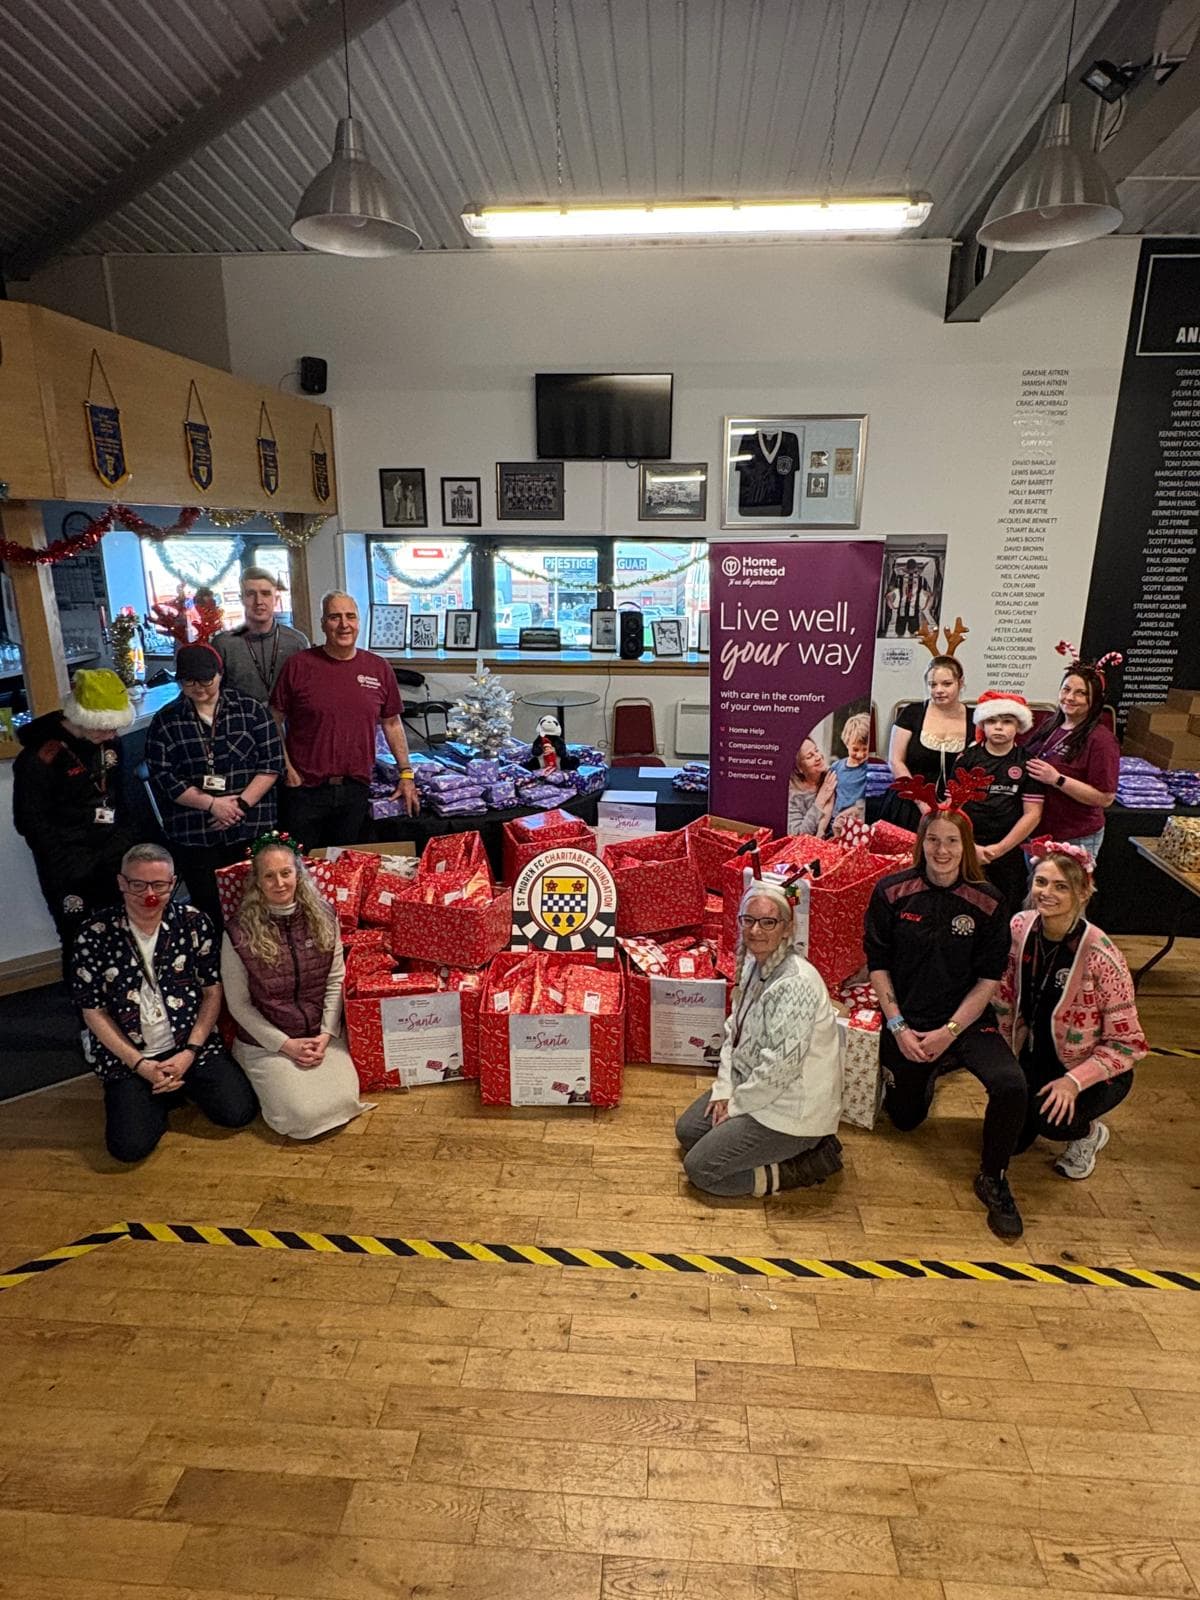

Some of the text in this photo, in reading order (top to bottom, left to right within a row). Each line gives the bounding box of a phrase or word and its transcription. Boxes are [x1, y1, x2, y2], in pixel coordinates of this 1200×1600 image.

[618, 559, 646, 569] GUAR
[743, 556, 777, 566] Home
[742, 566, 785, 576] Instead
[720, 602, 856, 635] Live well,
[720, 639, 790, 681] your
[798, 643, 862, 674] way
[721, 690, 739, 699] with
[761, 691, 771, 700] in
[772, 692, 787, 700] the
[789, 693, 825, 702] comfort
[721, 702, 729, 710] of
[730, 704, 751, 713] your
[773, 704, 800, 713] home
[749, 727, 765, 735] Help
[728, 742, 780, 752] Companionship
[728, 756, 773, 766] Personal Care
[728, 771, 776, 781] Dementia Care
[517, 852, 613, 908] ST MIRREN FC CHARITABLE FOUNDATION
[673, 990, 705, 1005] Santa
[408, 1013, 442, 1030] Santa
[535, 1032, 569, 1049] Santa
